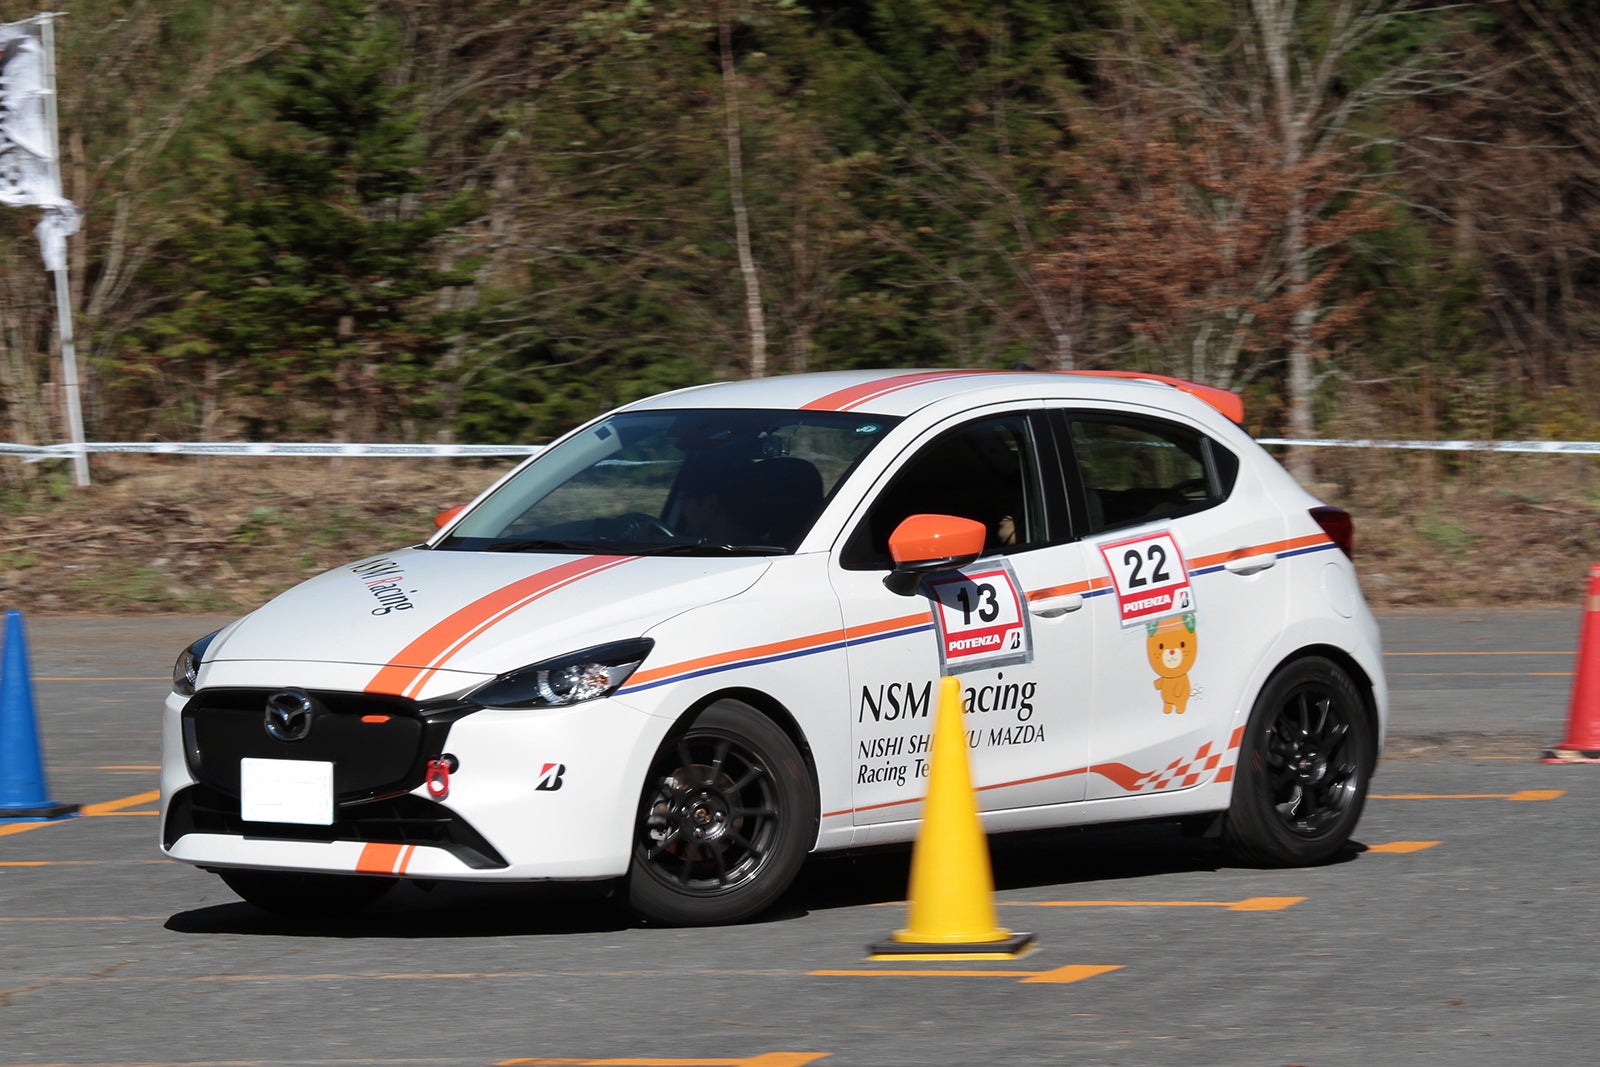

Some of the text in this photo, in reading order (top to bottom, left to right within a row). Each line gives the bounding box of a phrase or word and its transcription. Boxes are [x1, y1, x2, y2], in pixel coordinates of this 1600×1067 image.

[1123, 544, 1170, 588] 22
[365, 576, 418, 616] Racing
[957, 583, 999, 625] 13
[1123, 594, 1171, 613] POTENZA
[948, 634, 1001, 652] POTENZA
[858, 671, 1038, 723] NSM acing
[858, 724, 1046, 759] NISHI SHIU MAZDA
[857, 758, 931, 787] Racing Te
